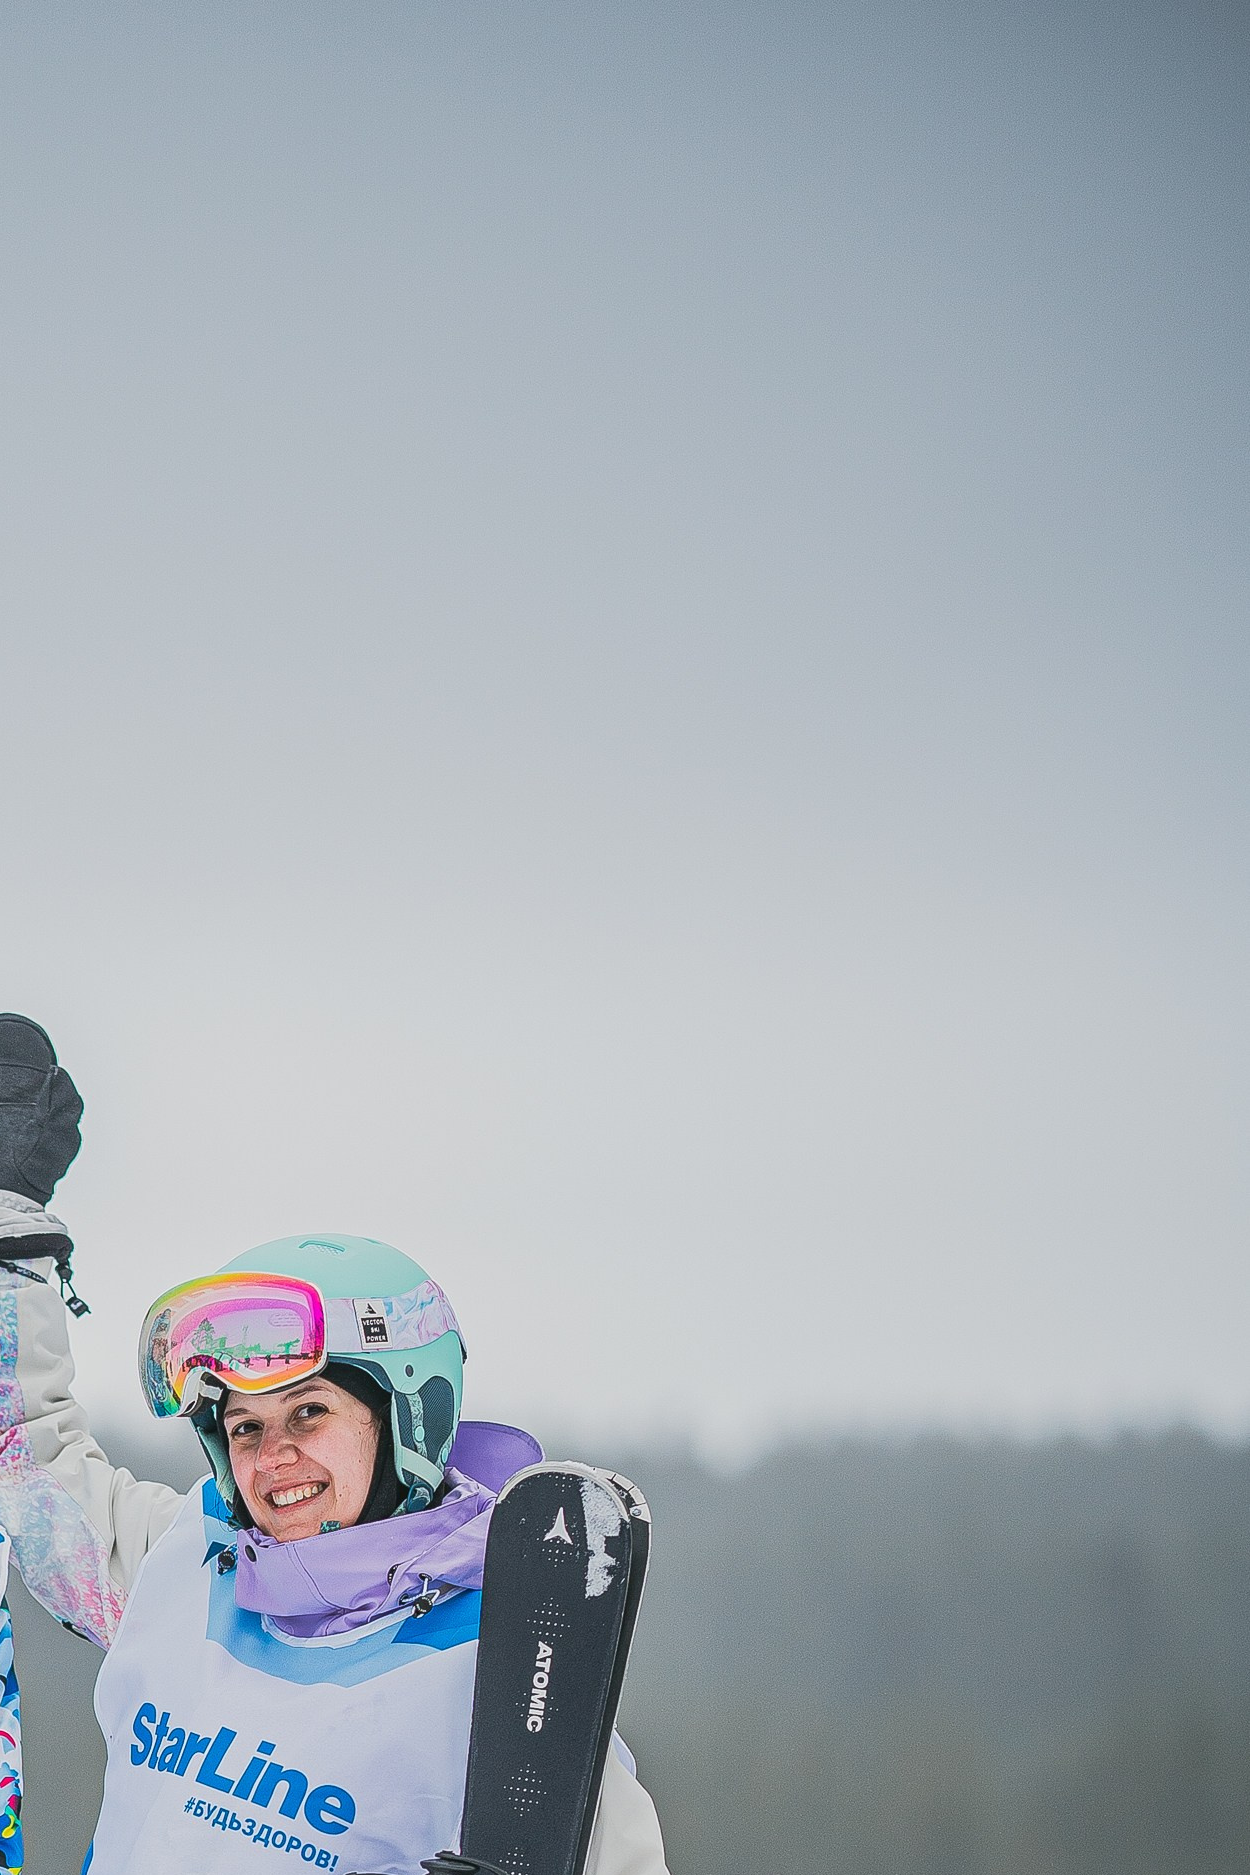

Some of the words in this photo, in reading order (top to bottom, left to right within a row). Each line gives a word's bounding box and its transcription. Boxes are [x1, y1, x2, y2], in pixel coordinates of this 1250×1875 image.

[526, 1640, 553, 1733] ATOMIC
[130, 1702, 357, 1836] StarLine
[184, 1796, 339, 1873] #БУДЬЗДОРОВ!
